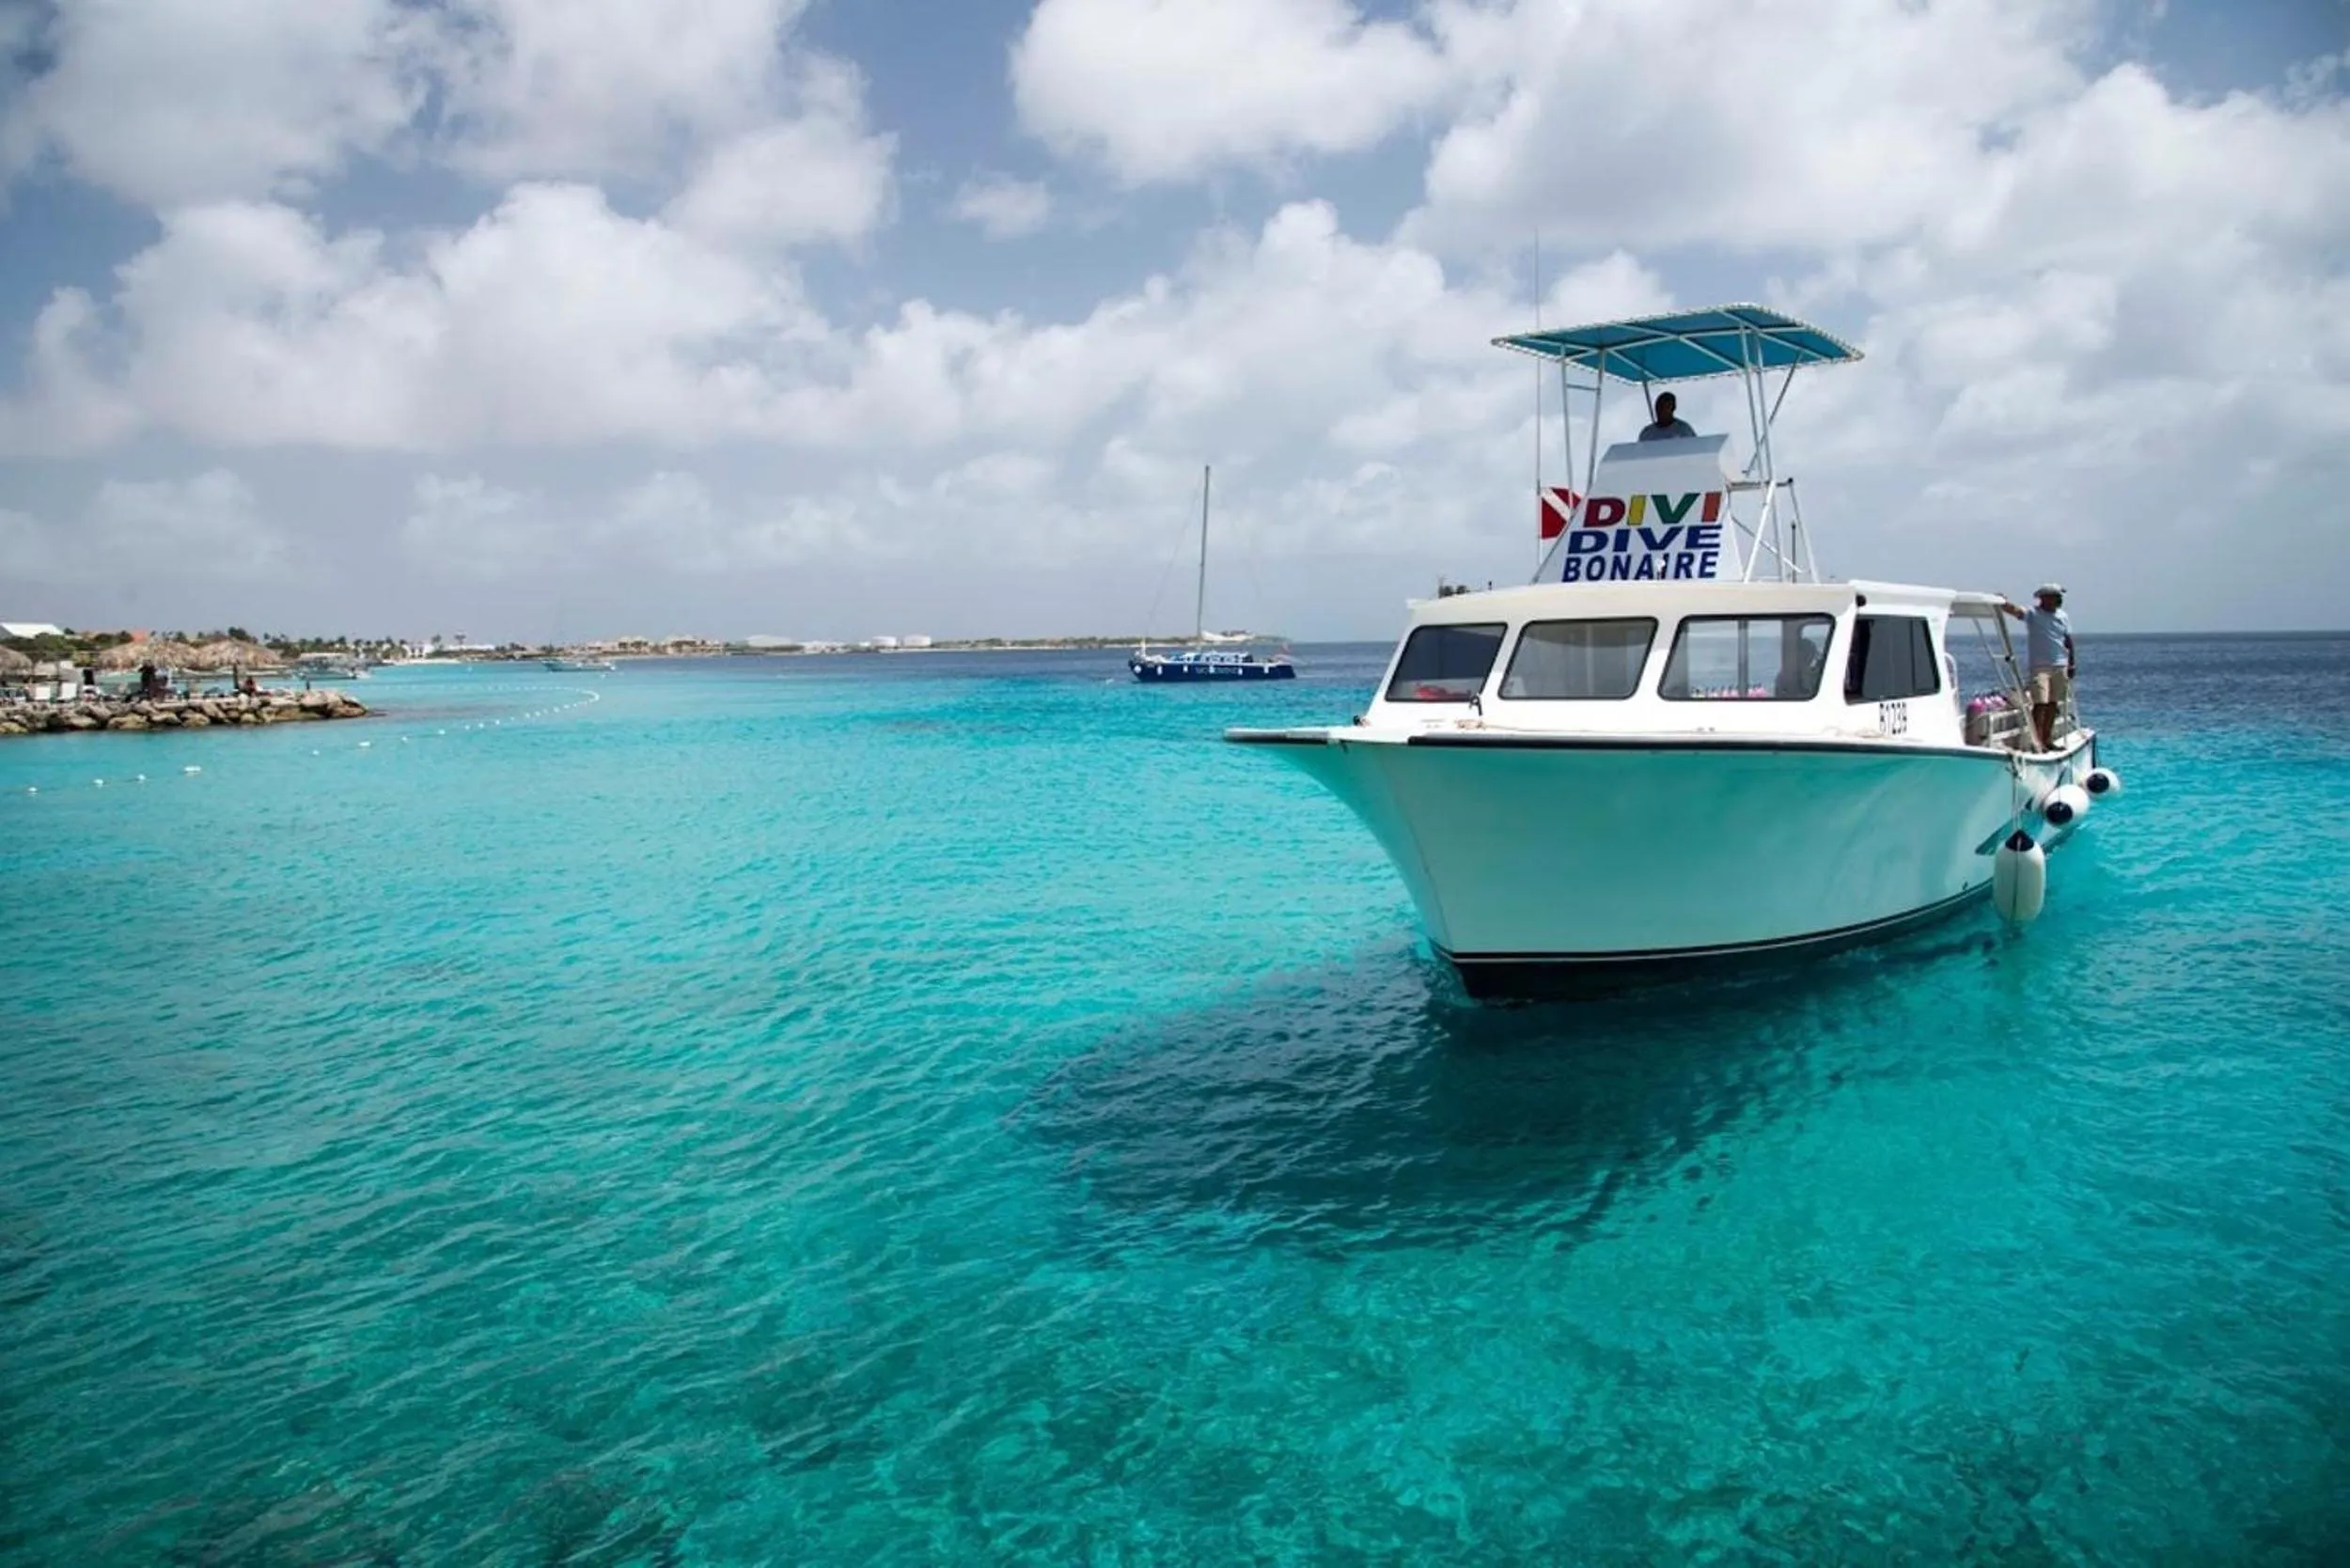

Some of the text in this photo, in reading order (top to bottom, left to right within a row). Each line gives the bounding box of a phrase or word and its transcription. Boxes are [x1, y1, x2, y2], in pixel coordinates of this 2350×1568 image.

[1583, 491, 1723, 527] DIVI
[1567, 525, 1723, 554] DIVE
[1561, 552, 1718, 583] BONAIRE
